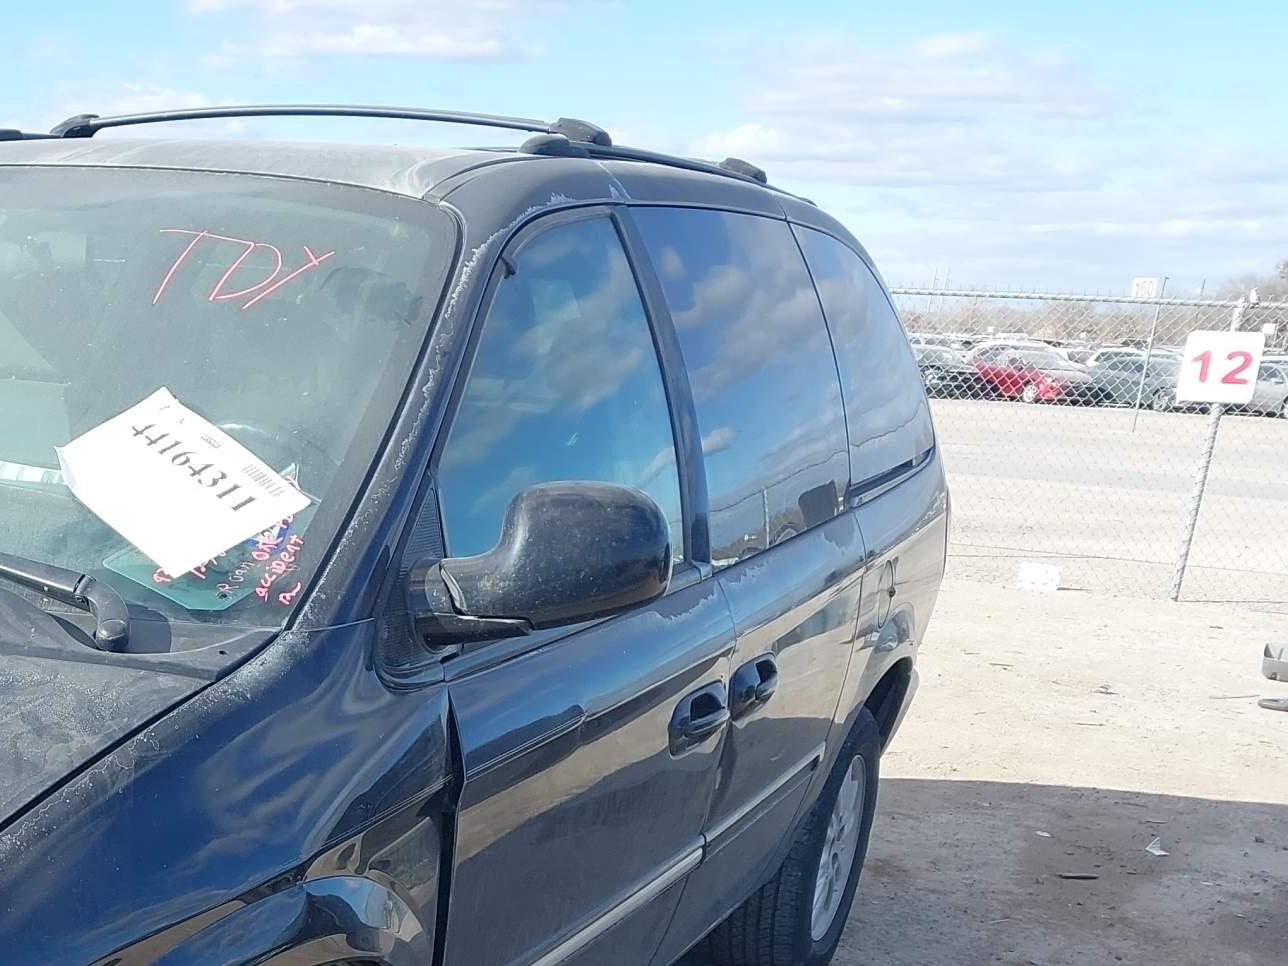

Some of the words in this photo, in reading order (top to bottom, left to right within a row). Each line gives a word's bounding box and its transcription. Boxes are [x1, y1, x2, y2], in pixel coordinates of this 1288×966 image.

[152, 228, 336, 311] TDY
[1192, 350, 1253, 385] 12
[131, 422, 257, 512] 44164311
